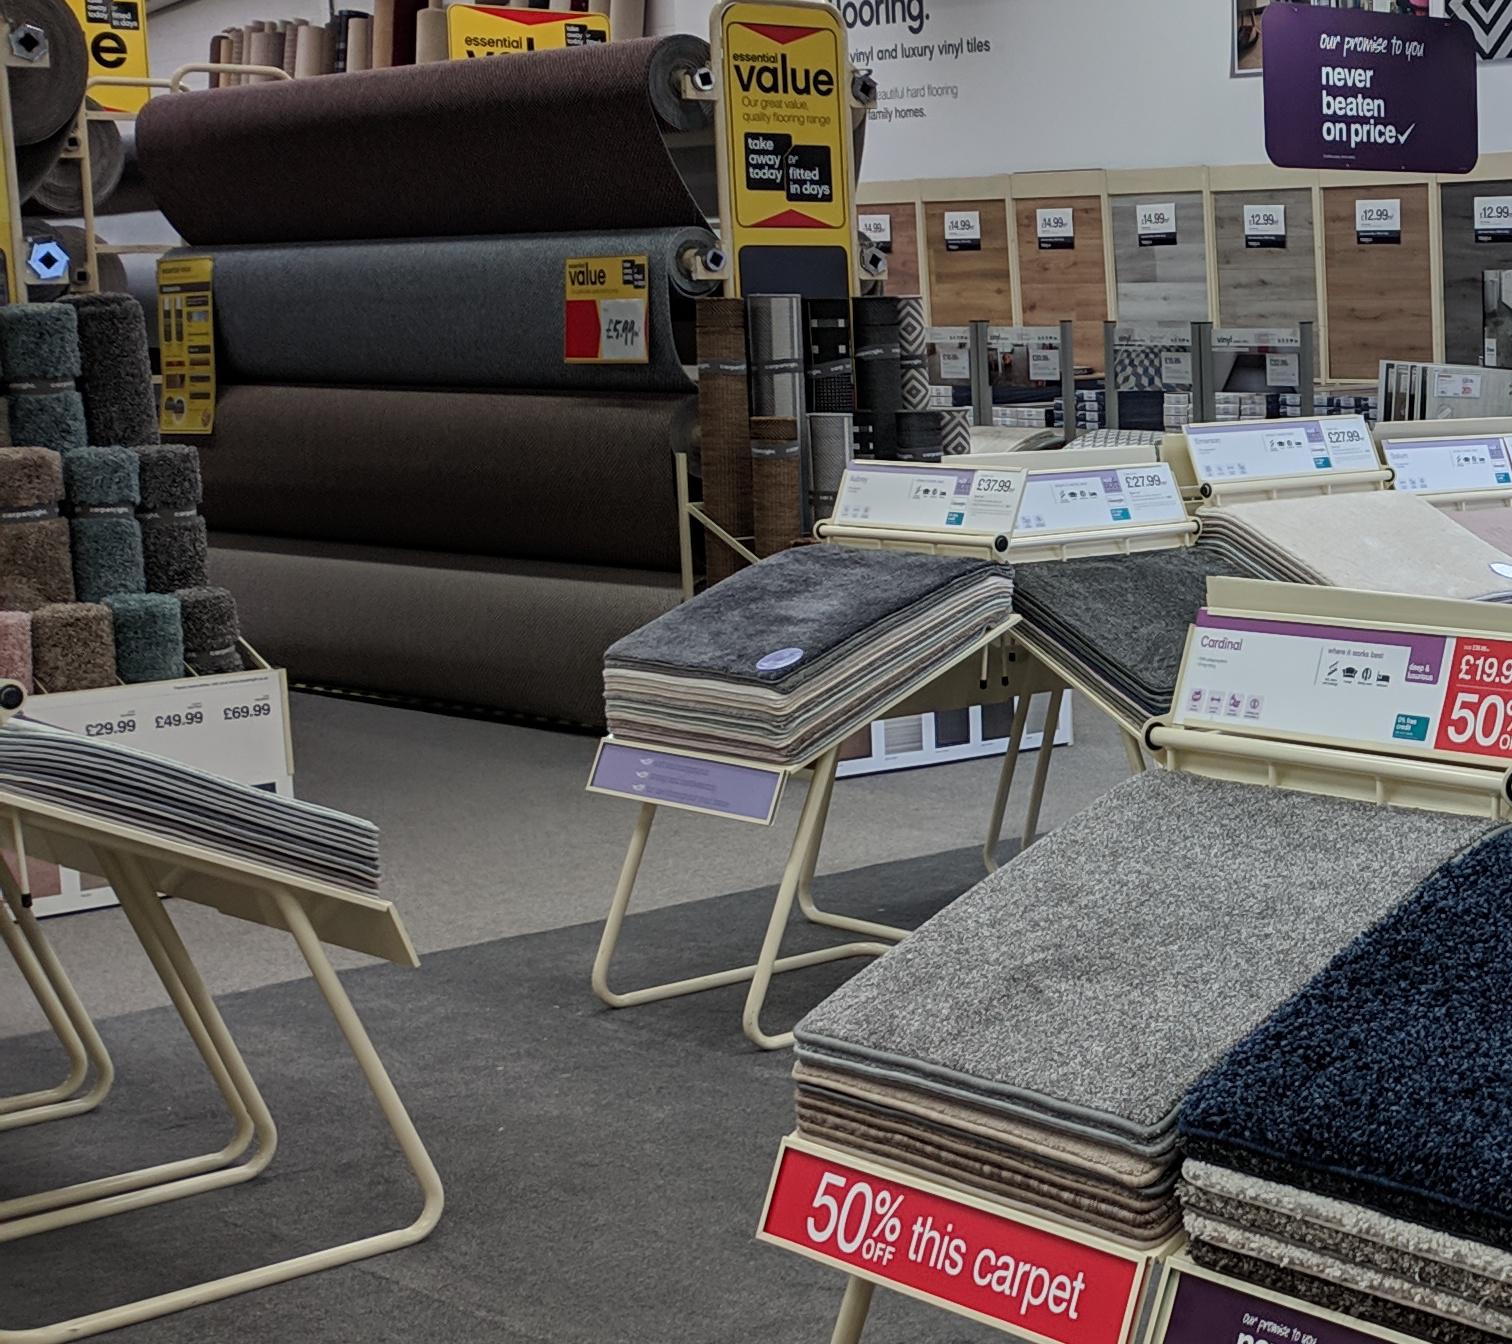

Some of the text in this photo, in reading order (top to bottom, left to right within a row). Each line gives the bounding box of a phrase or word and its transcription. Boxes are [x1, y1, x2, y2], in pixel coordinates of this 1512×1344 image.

[876, 36, 991, 62] and luxury vinyl tiles
[733, 53, 834, 96] value
[1321, 66, 1374, 88] never
[906, 83, 959, 100] hard flooring
[894, 106, 927, 119] homes.
[1321, 89, 1385, 118] beaten
[743, 112, 831, 128] quality flooring range
[1322, 118, 1397, 149] on price
[748, 136, 775, 151] take
[748, 154, 782, 168] away
[749, 166, 820, 183] today fitted
[802, 183, 831, 198] days
[568, 261, 607, 286] value
[1200, 634, 1244, 651] Cardinal
[85, 702, 271, 737] £29.99 £49.99 £69.99
[806, 1171, 1086, 1320] 50% OFF this carpet
